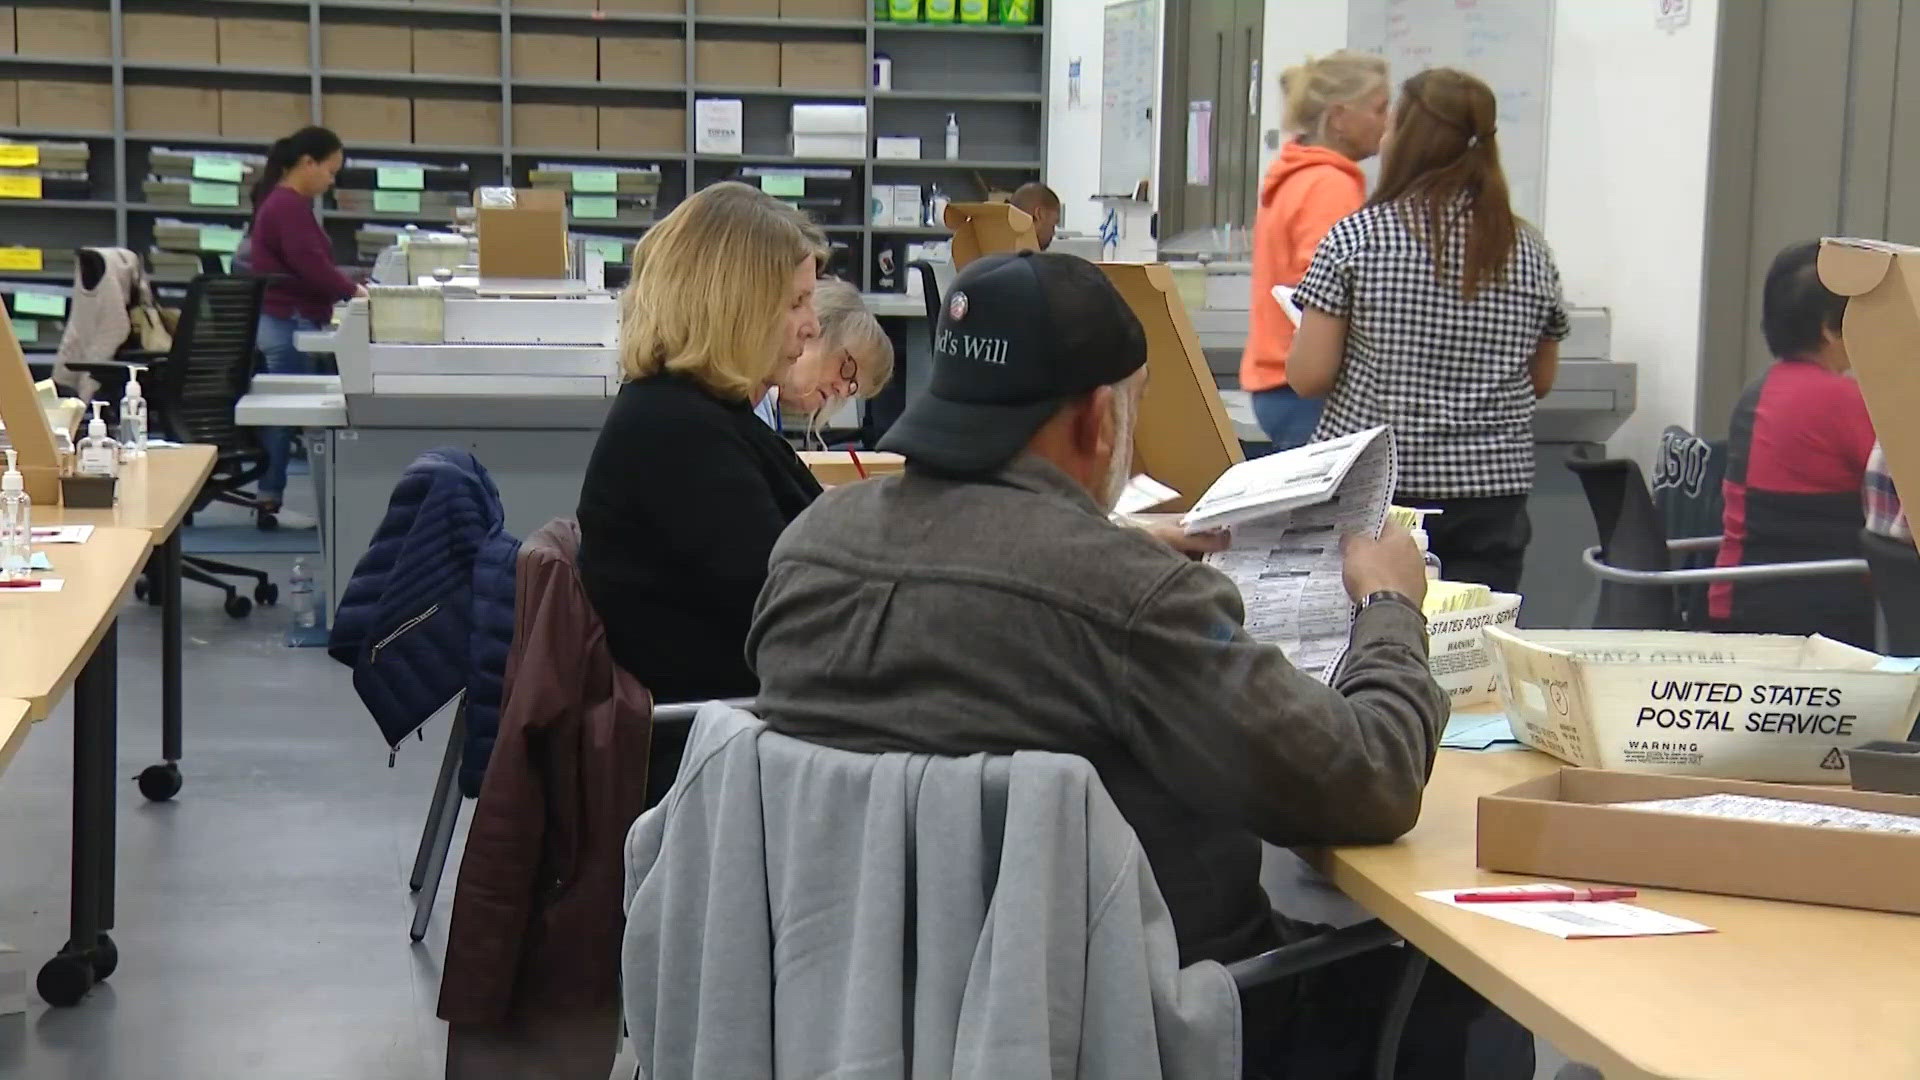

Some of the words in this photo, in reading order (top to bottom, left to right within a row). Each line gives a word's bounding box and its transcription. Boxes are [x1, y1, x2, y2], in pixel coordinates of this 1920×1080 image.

[936, 330, 958, 356] d's
[963, 335, 1009, 365] Will
[1431, 619, 1464, 636] STATES
[1464, 613, 1494, 630] POSTAL
[1650, 680, 1743, 703] UNITED
[1750, 684, 1842, 707] STATES
[1635, 707, 1735, 732] POSTAL
[1744, 712, 1857, 736] SERVICE
[1629, 741, 1698, 752] WARNING
